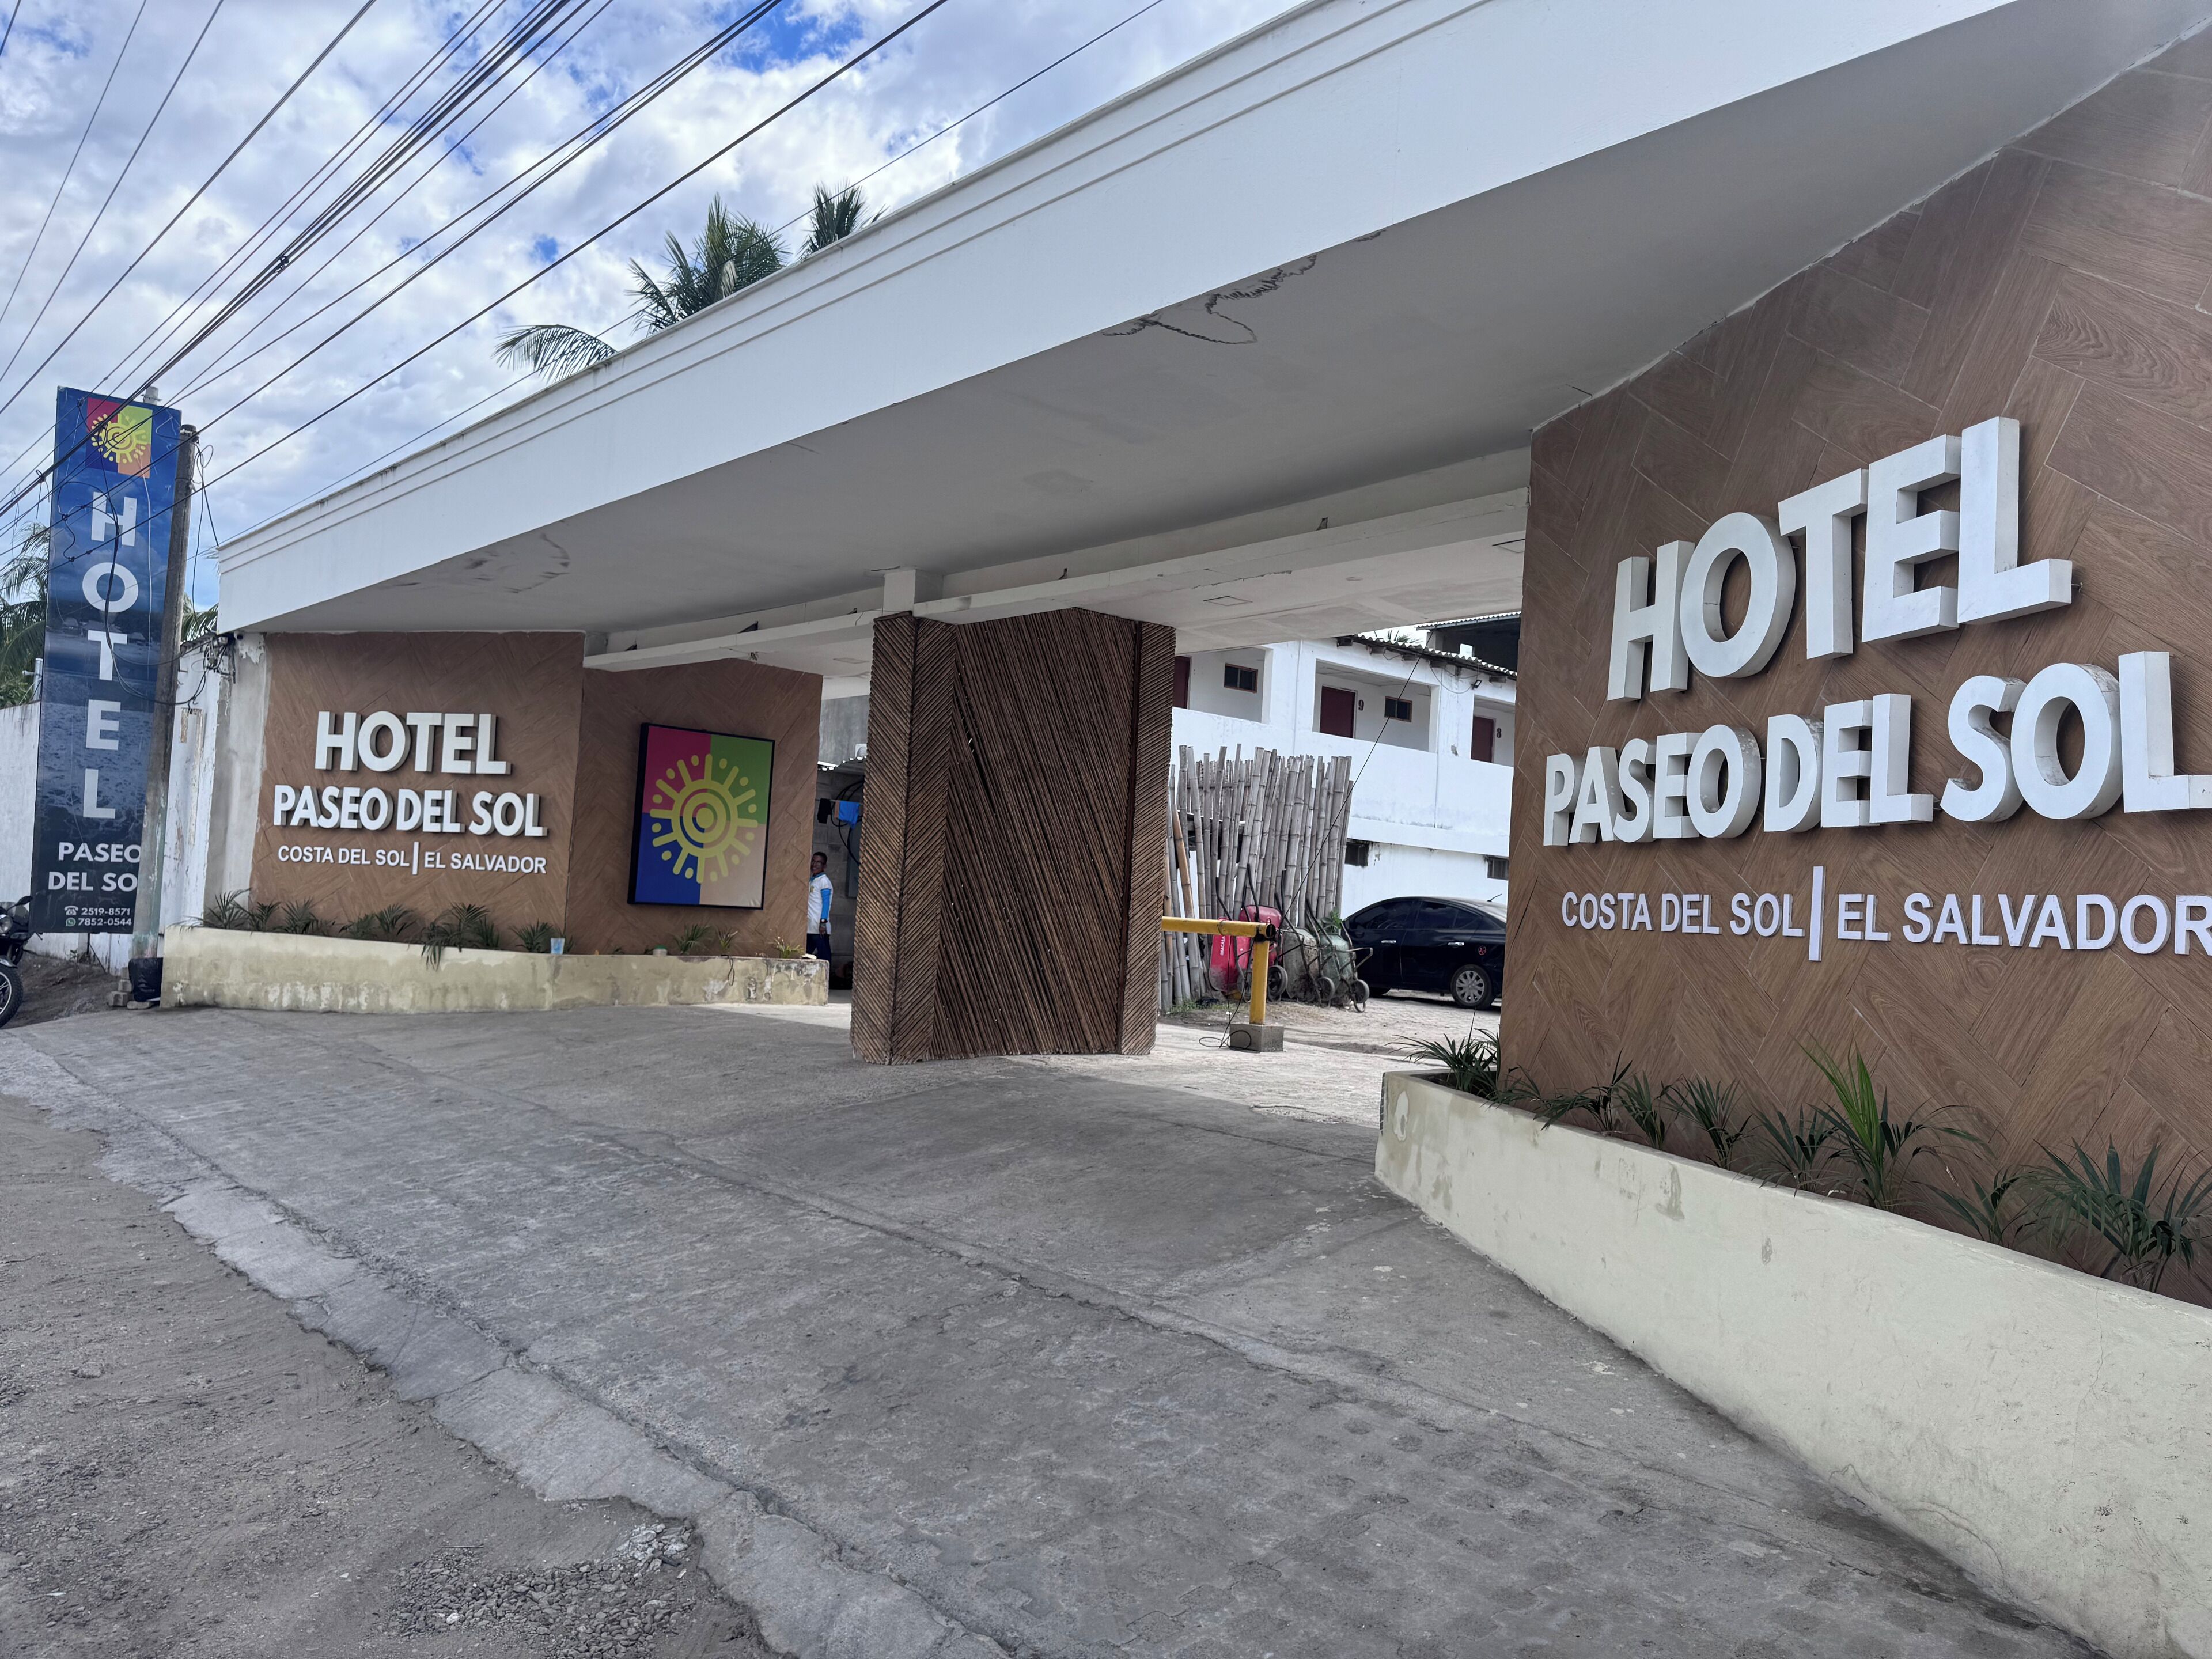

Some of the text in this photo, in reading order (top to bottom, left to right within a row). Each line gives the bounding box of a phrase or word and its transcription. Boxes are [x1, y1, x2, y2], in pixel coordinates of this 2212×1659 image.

[1607, 416, 2073, 702] HOTEL
[82, 491, 139, 819] HOTEL
[1358, 699, 1365, 711] 9
[315, 711, 512, 774] HOTEL
[1496, 728, 1502, 738] 8
[1543, 650, 2212, 847] PASEO DEL SOL
[274, 785, 548, 836] PASEO DEL SOL
[58, 842, 141, 863] PASEO
[278, 845, 547, 874] COSTA DEL SOL EL SALVADOR
[48, 871, 138, 892] DEL SO
[78, 918, 132, 926] 7852-0544
[81, 907, 130, 916] 2519-8571
[1562, 891, 2212, 956] COSTA DEL SOL EL SALVADOR
